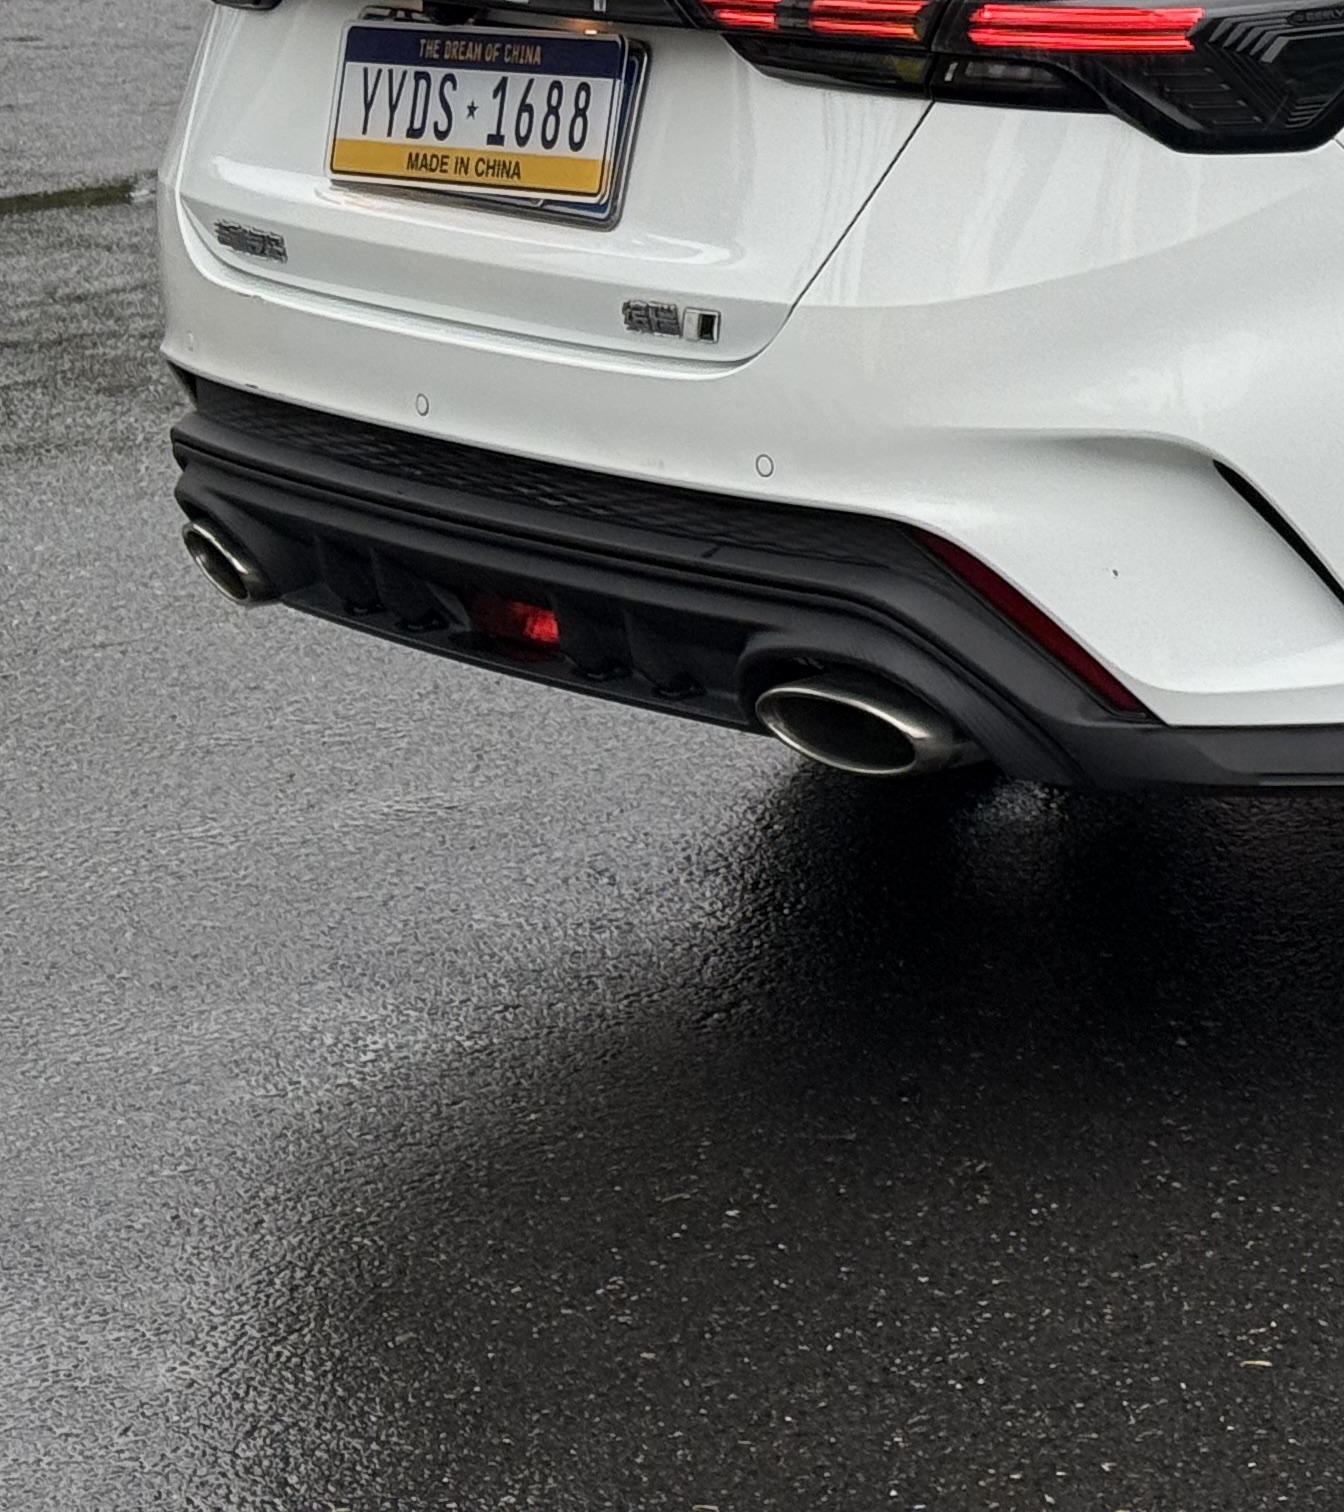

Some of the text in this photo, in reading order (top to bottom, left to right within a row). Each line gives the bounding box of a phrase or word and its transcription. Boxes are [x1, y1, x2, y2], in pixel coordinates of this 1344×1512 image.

[419, 39, 541, 65] THE DREAM OF CHINA
[362, 66, 592, 152] YYDS 1688
[406, 152, 521, 180] MADE IN CHINA
